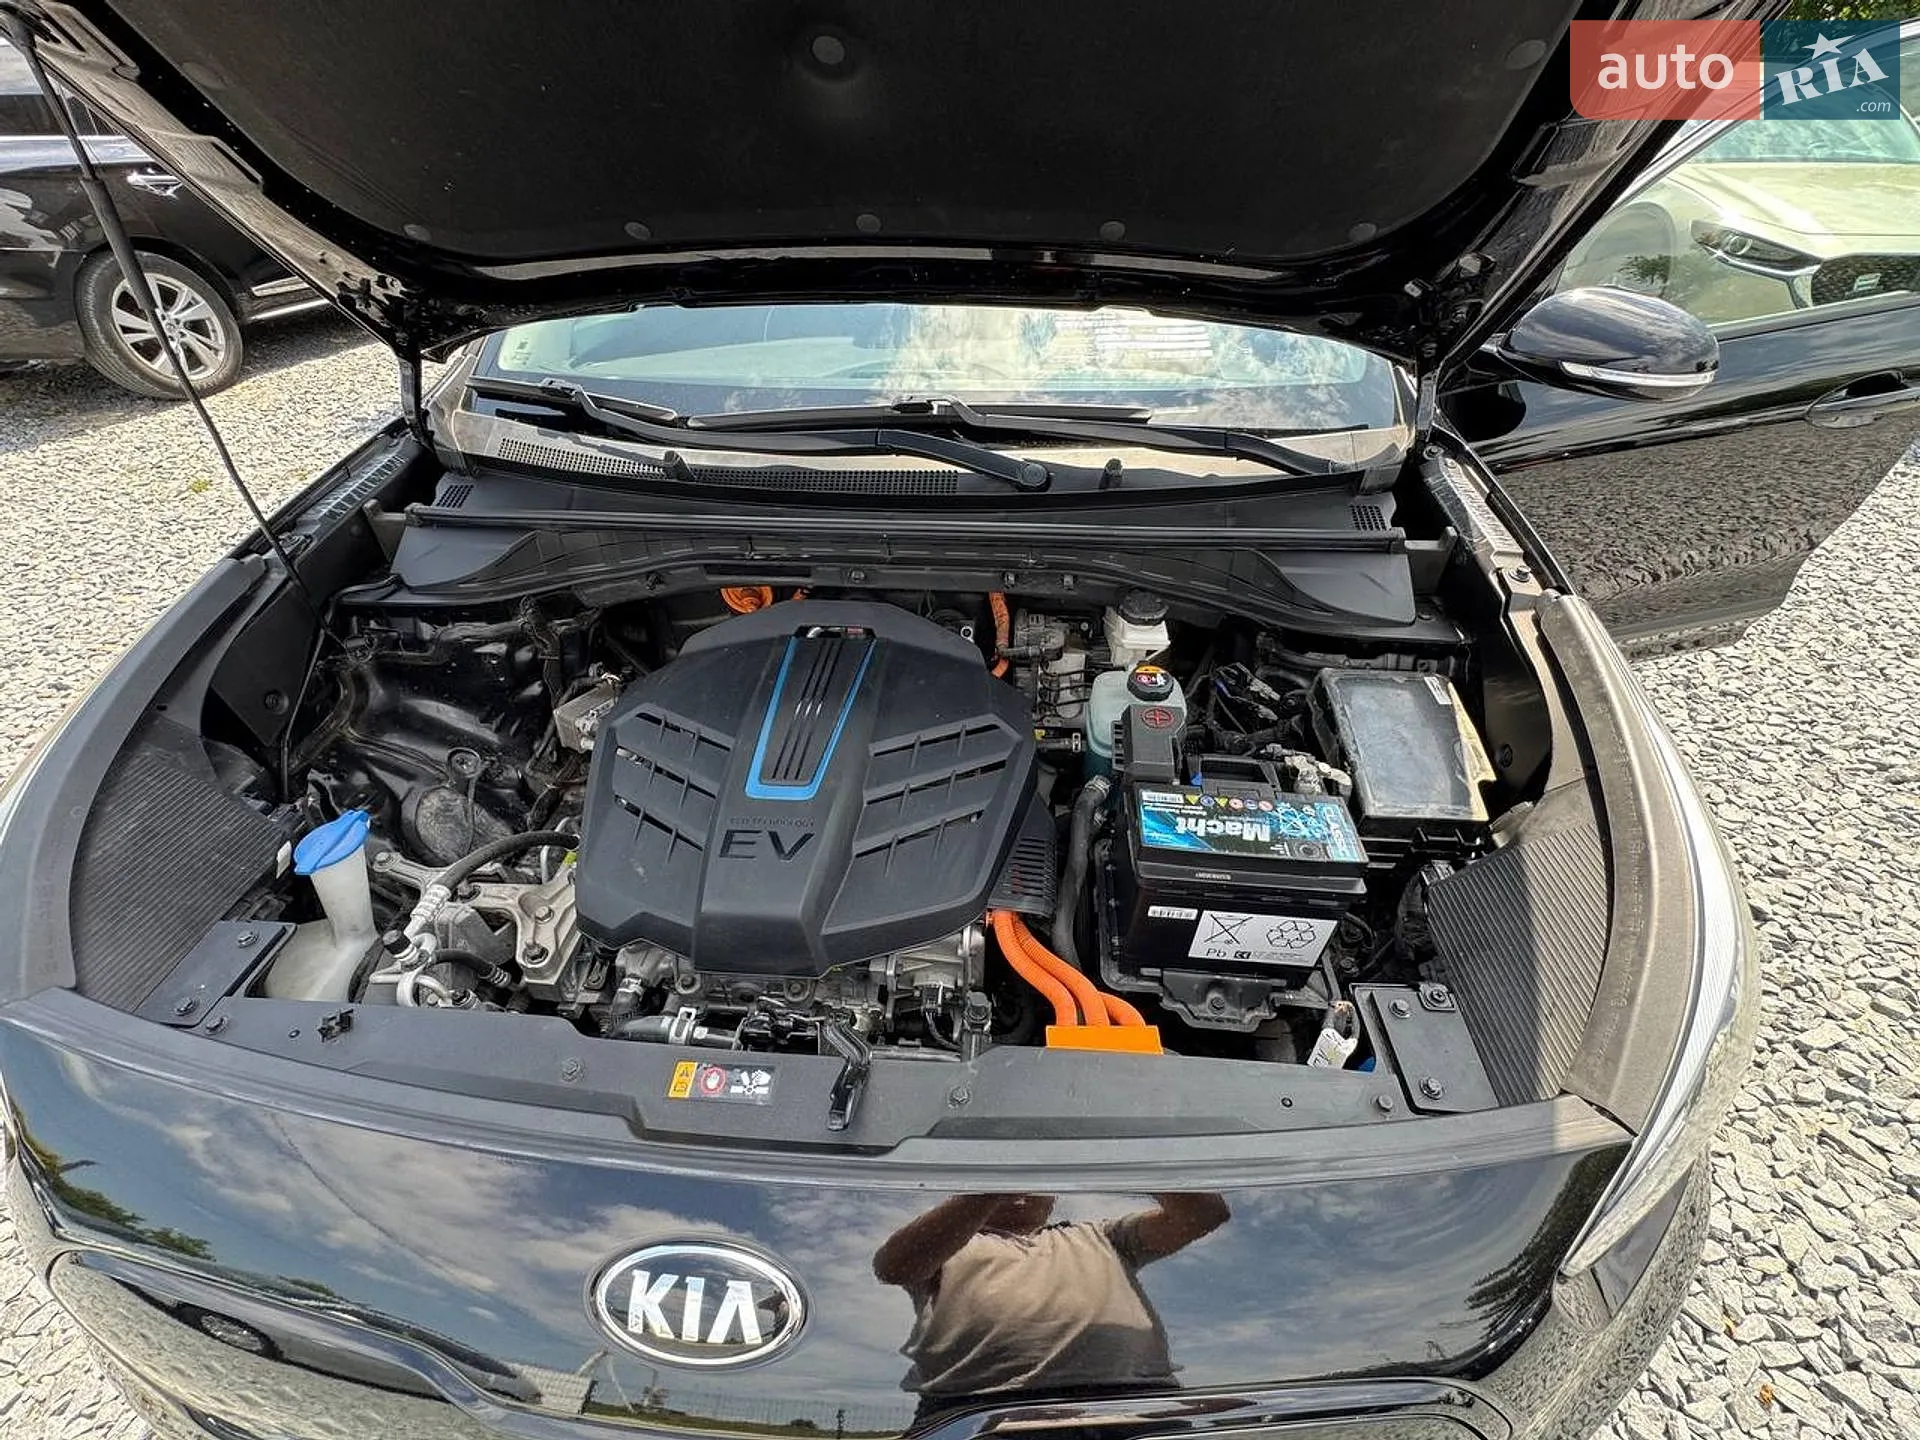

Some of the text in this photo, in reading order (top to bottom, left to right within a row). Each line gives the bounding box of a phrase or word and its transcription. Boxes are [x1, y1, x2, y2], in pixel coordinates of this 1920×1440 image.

[1174, 814, 1272, 843] Macht
[719, 829, 816, 861] EV
[1206, 947, 1227, 958] Pb
[627, 1269, 763, 1344] KIA
